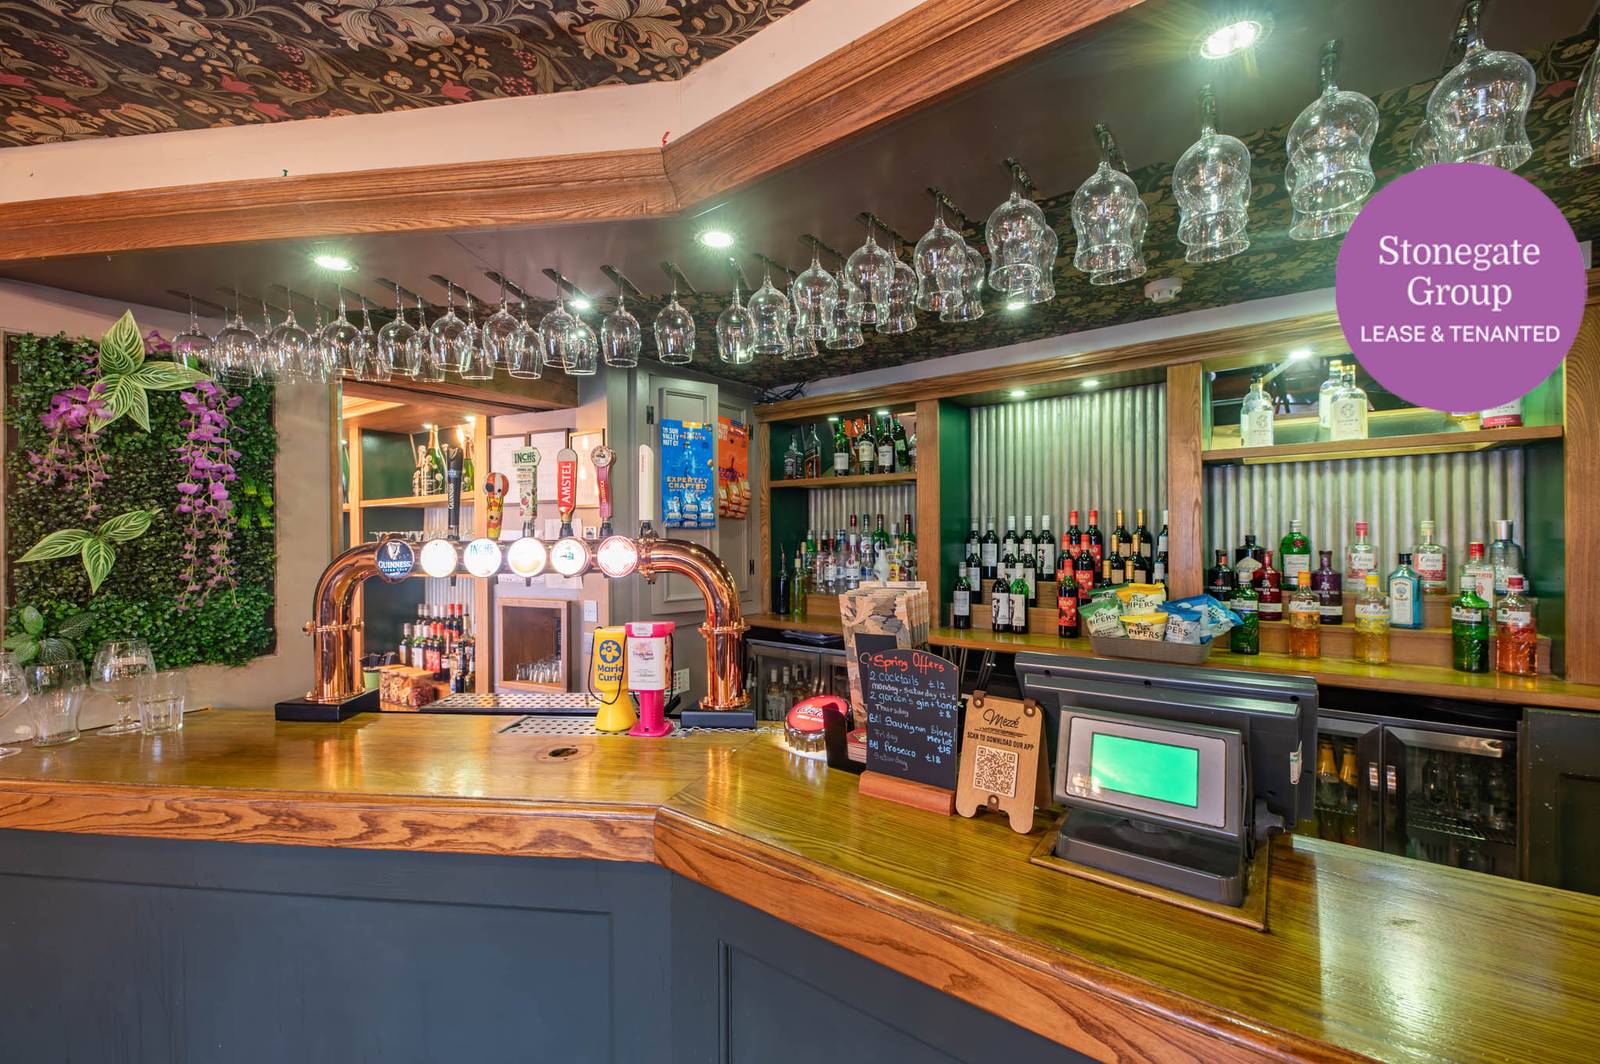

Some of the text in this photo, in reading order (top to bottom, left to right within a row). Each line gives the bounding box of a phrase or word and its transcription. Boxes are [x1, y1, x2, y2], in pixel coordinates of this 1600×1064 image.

[561, 463, 572, 503] AMSTEL
[378, 560, 412, 569] GUINNESS
[1128, 628, 1160, 639] PIPERS
[873, 652, 945, 675] Spring Offers
[869, 671, 877, 681] 2
[878, 672, 920, 686] cocktails
[869, 692, 877, 700] 2
[967, 731, 979, 741] SCAN
[986, 735, 1013, 748] DOWNLOAD
[1013, 741, 1024, 750] OUR
[1024, 742, 1034, 751] APP
